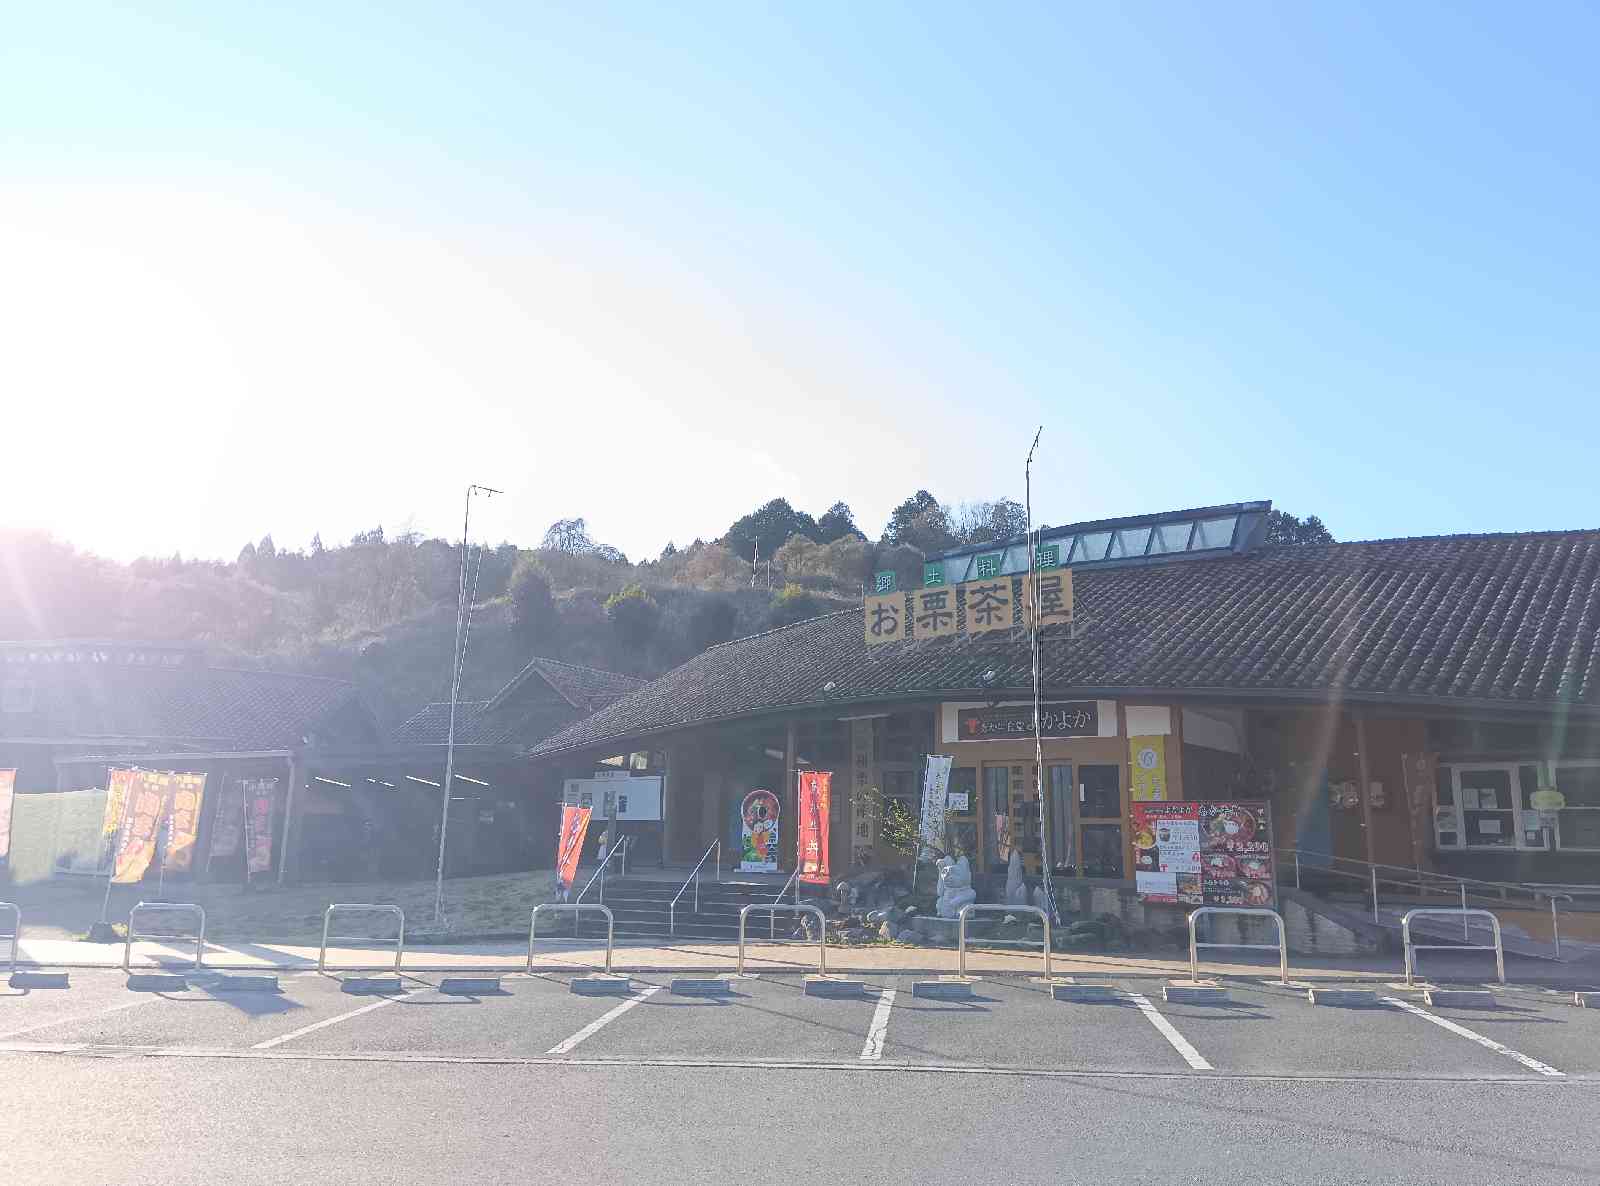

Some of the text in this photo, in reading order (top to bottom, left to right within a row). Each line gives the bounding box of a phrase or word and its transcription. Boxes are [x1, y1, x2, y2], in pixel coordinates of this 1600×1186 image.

[875, 551, 1055, 593] 郷土料理
[869, 575, 1071, 637] お栗茶屋
